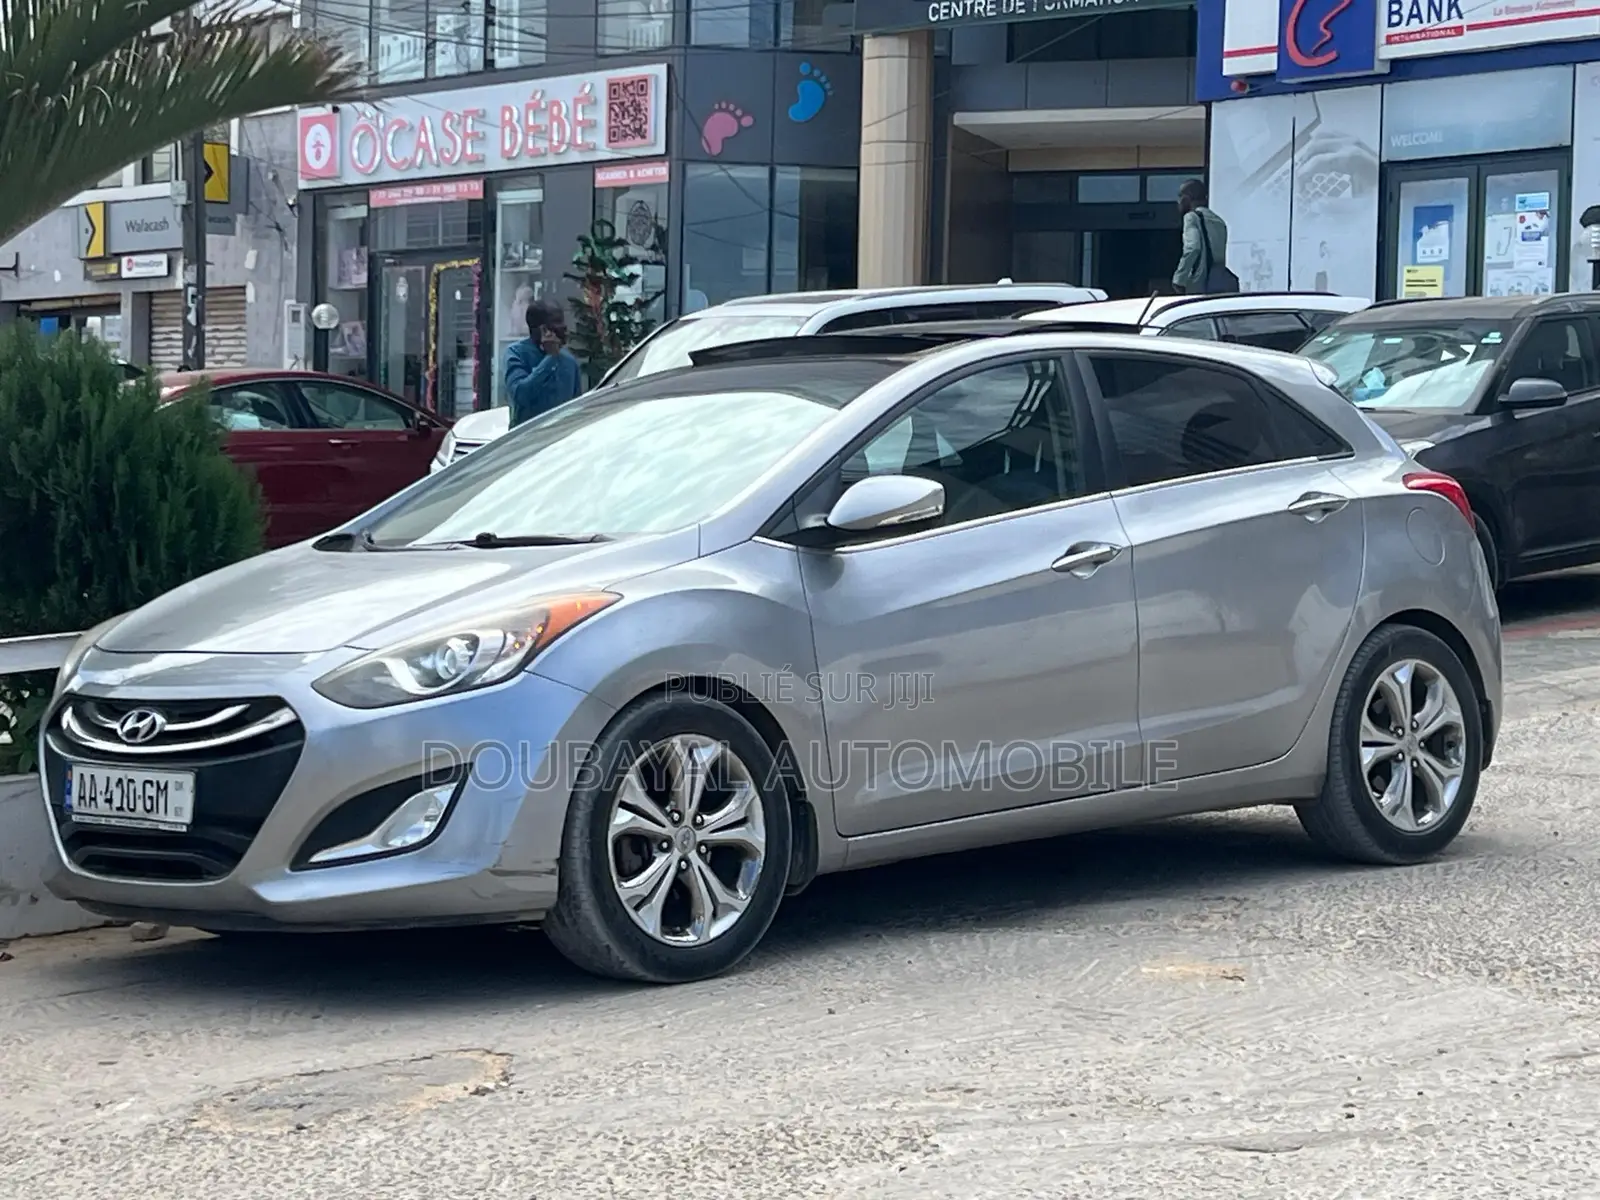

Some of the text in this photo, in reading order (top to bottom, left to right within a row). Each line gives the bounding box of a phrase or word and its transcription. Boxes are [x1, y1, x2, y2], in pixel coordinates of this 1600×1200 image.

[928, 0, 997, 21] CENTRE
[1002, 0, 1026, 14] DE
[1387, 0, 1464, 28] BANK
[1391, 29, 1456, 42] INTERNATIONAL
[500, 81, 596, 160] BÉBÉ
